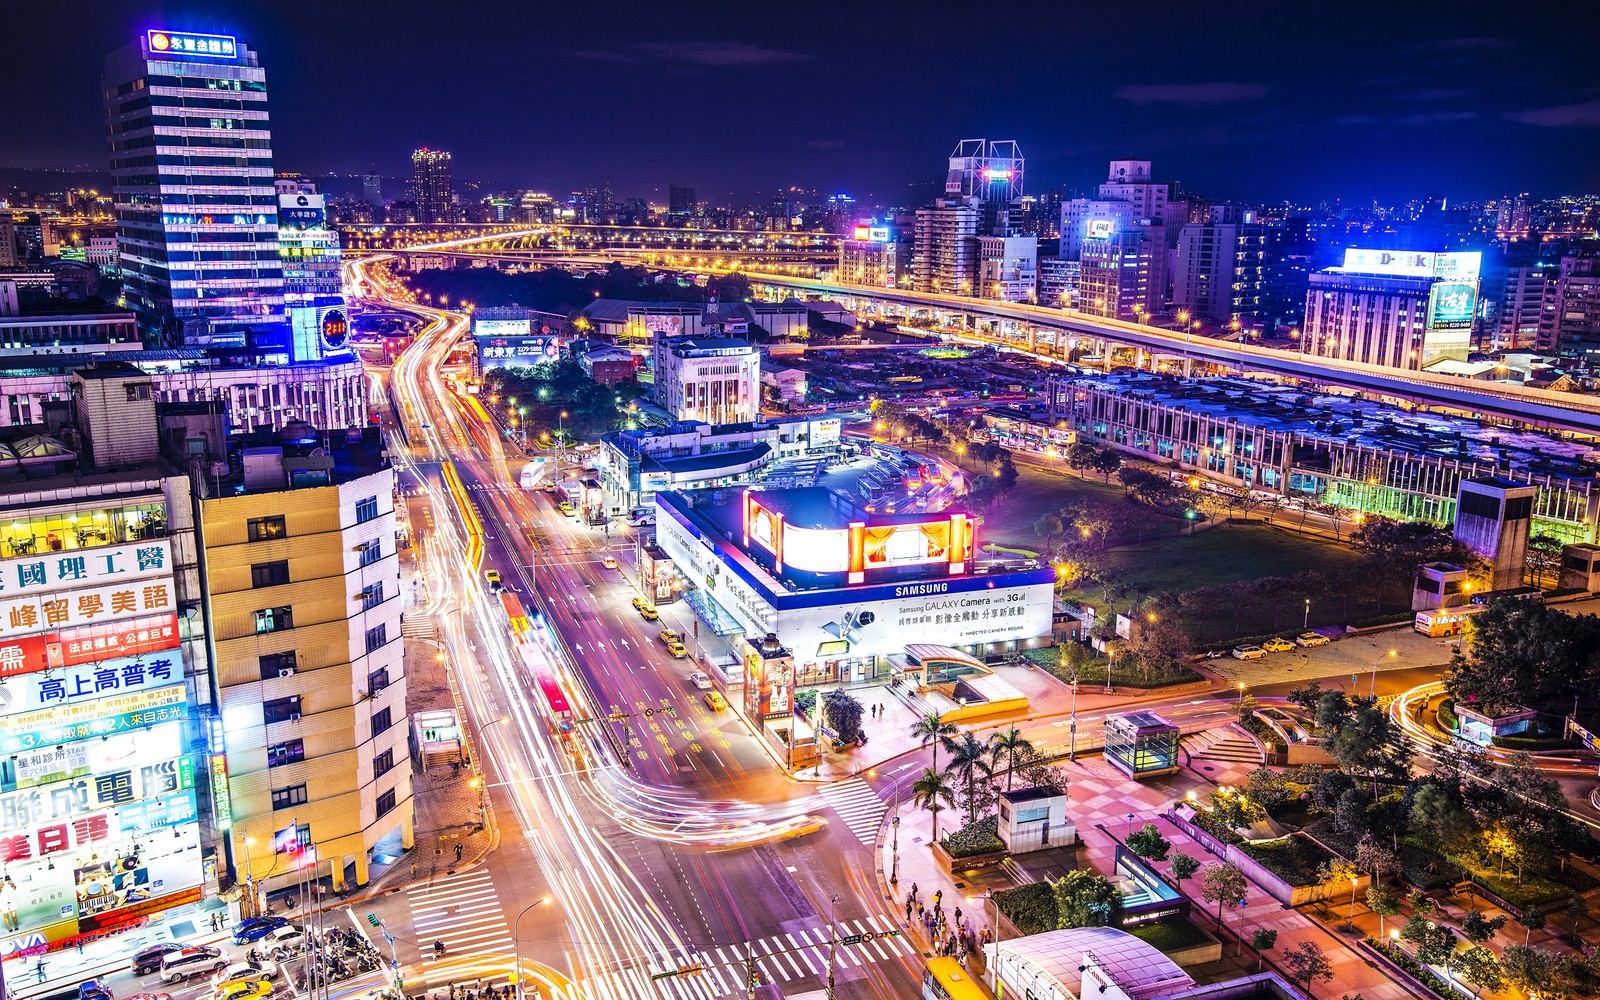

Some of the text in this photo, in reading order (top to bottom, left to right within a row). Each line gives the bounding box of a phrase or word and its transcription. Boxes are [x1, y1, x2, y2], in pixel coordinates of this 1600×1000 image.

[895, 583, 948, 596] SAMSUNG
[899, 605, 924, 614] Samsung
[925, 600, 959, 611] GALAXY
[960, 596, 990, 607] Camera
[1007, 594, 1019, 602] 3G
[0, 584, 168, 632] 峰留學美語
[38, 659, 173, 703] 高上高普考
